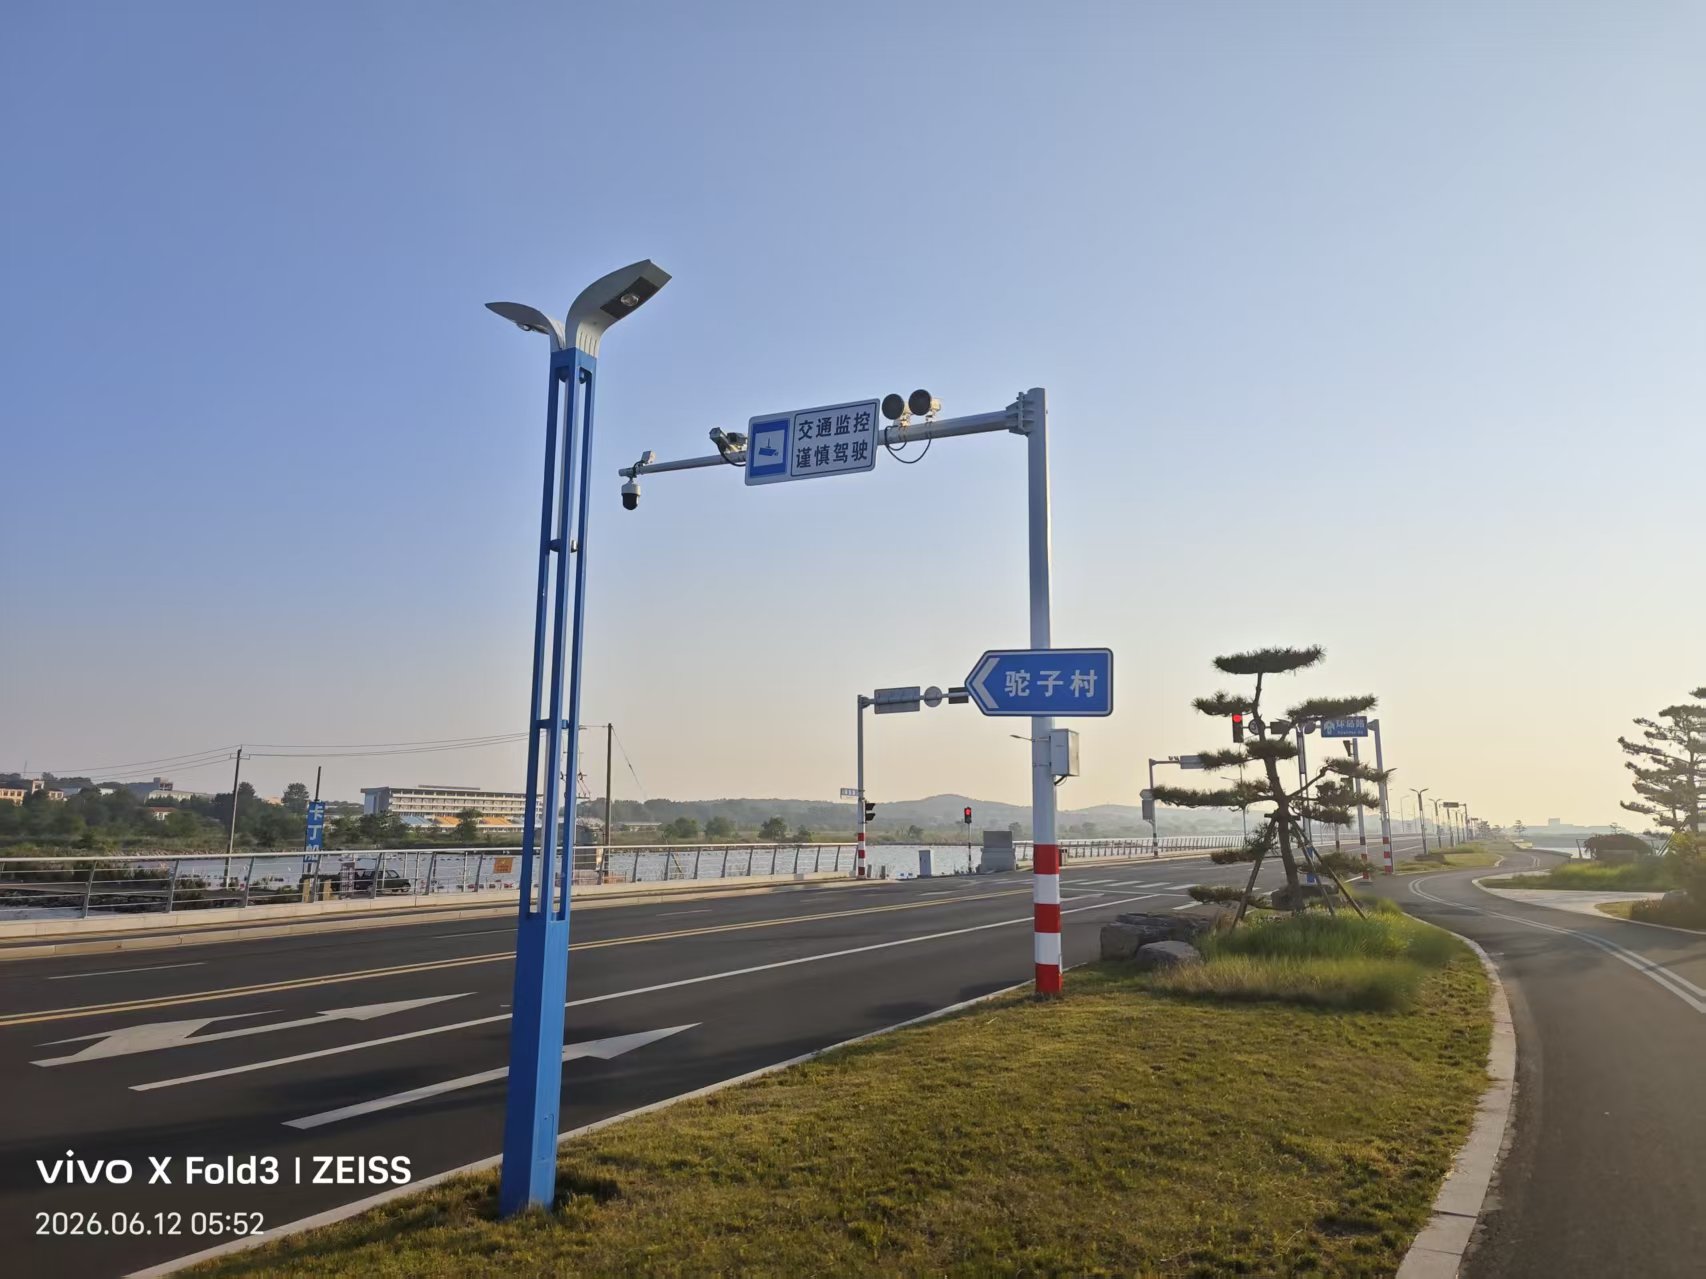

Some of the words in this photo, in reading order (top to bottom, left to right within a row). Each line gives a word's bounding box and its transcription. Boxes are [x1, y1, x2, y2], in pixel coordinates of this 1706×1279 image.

[798, 411, 871, 441] 交通监控
[796, 439, 869, 469] 谨慎驾驶
[1004, 669, 1097, 698] 驼子村
